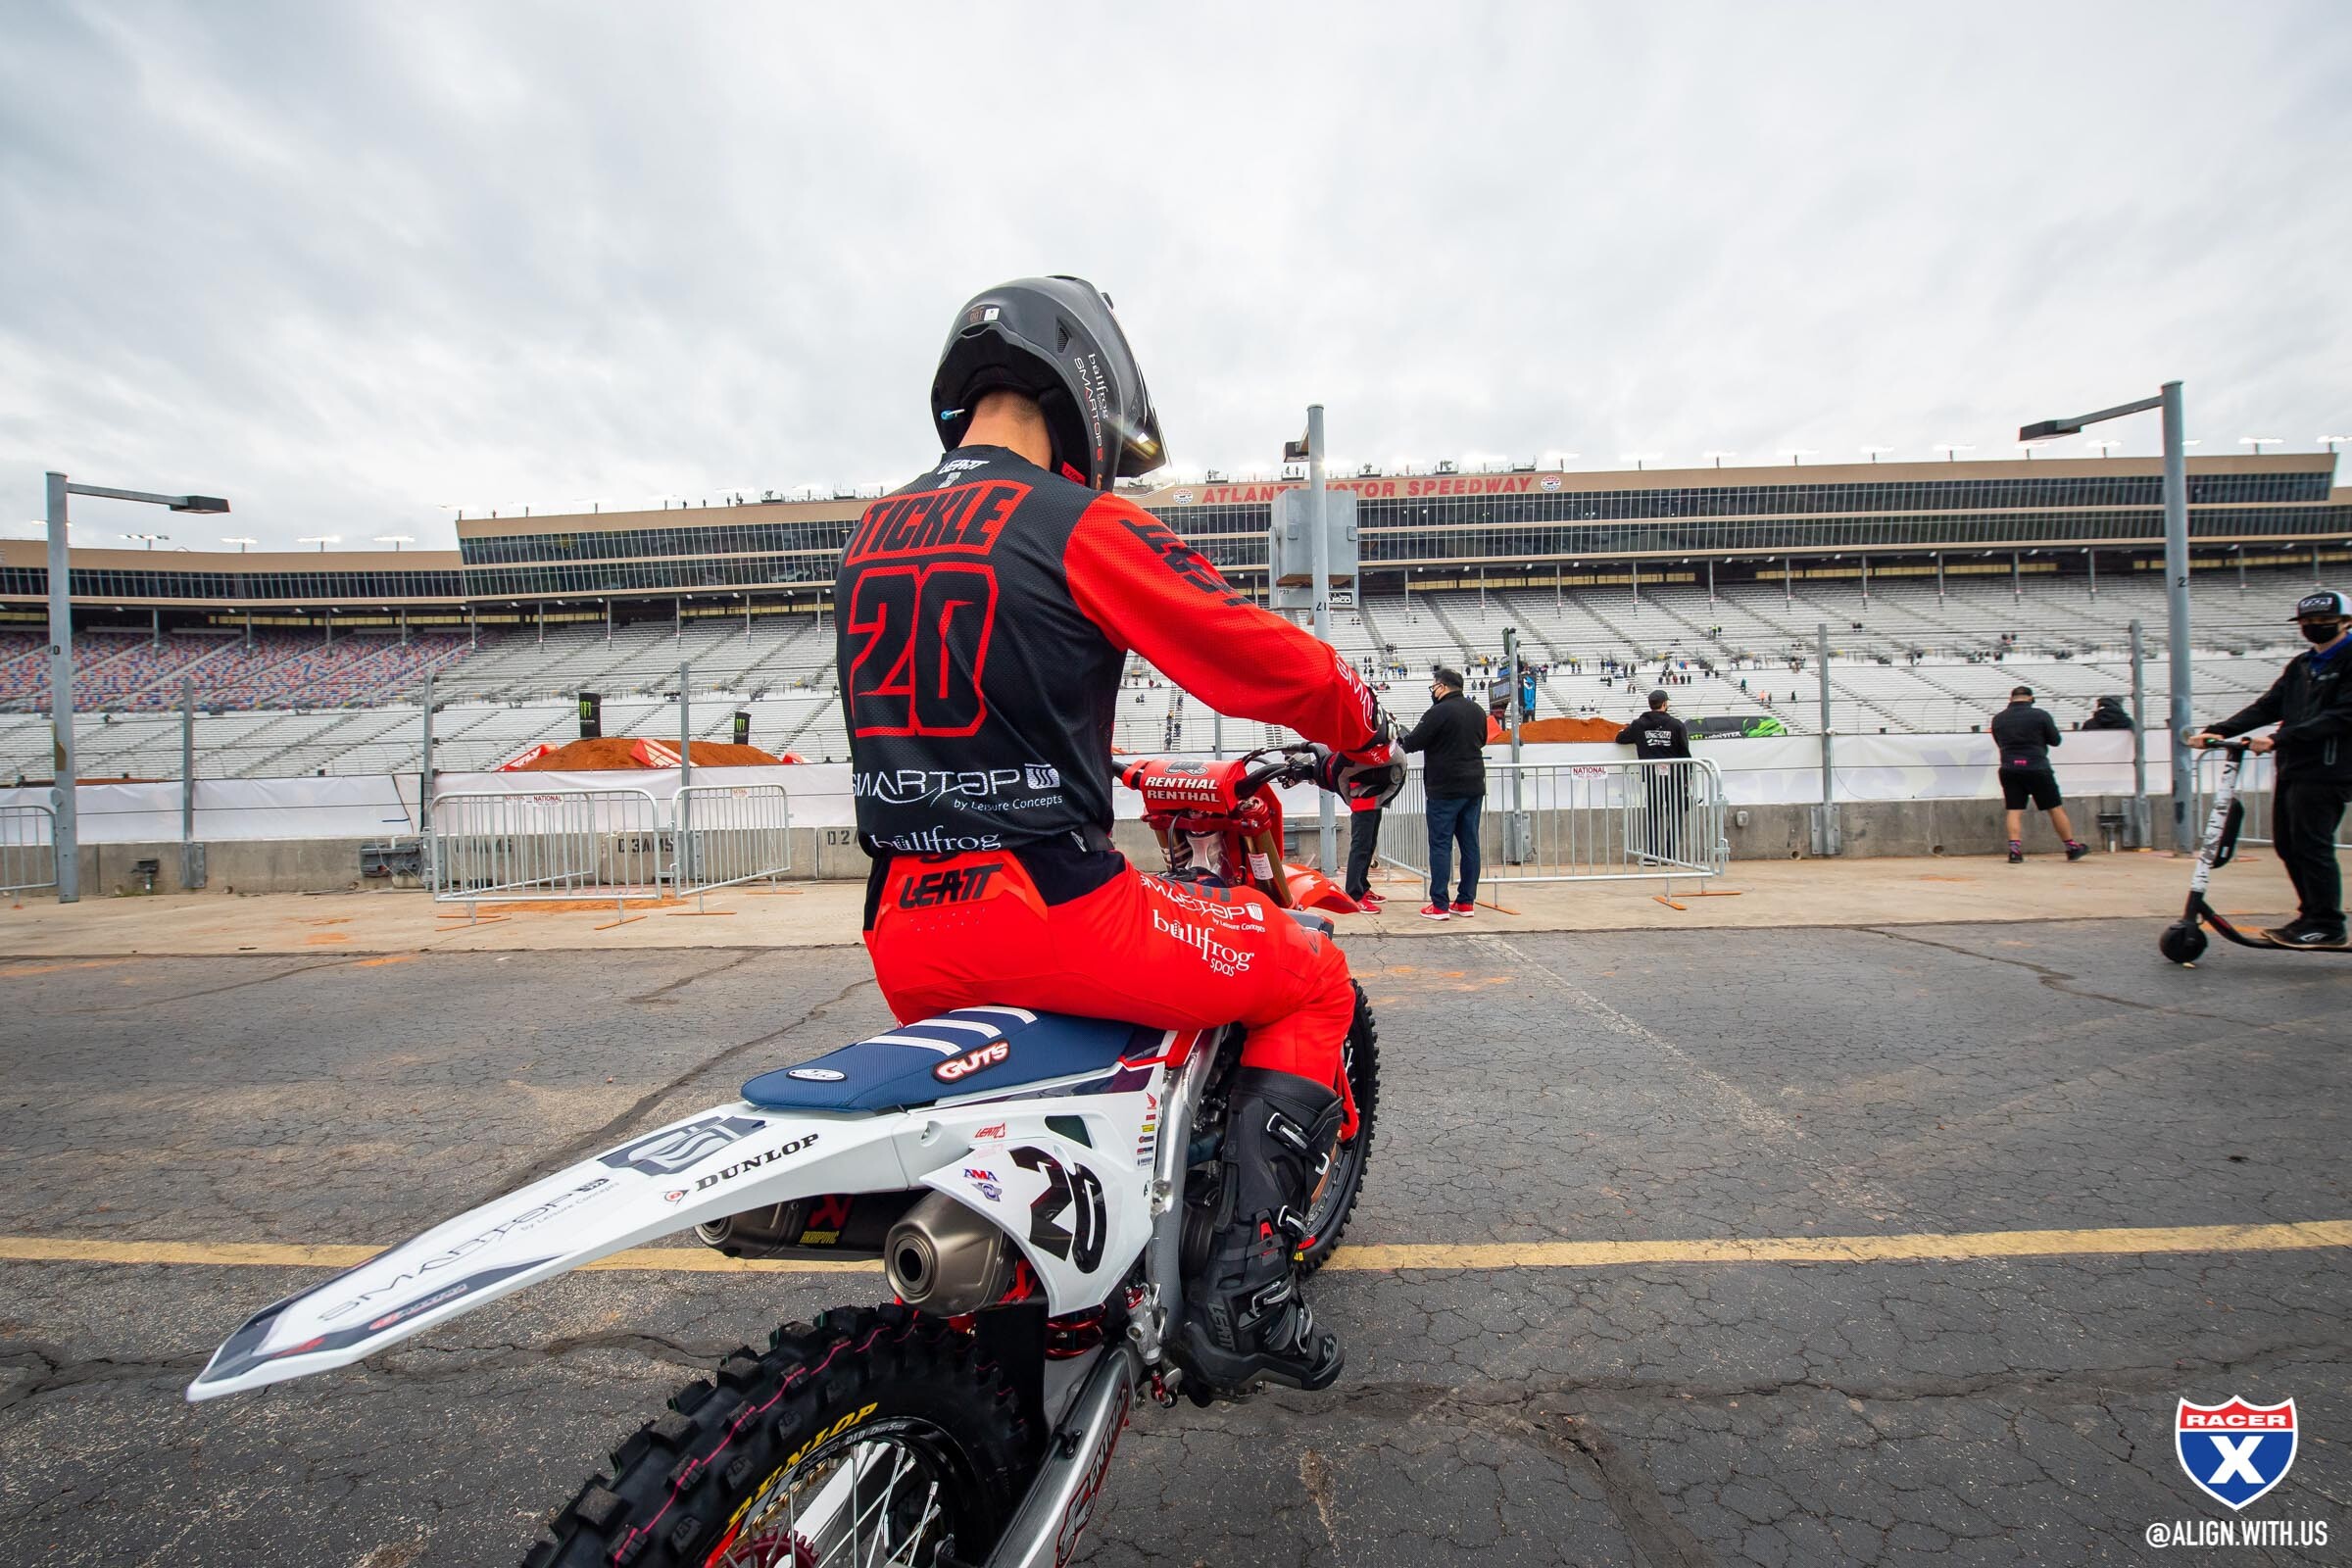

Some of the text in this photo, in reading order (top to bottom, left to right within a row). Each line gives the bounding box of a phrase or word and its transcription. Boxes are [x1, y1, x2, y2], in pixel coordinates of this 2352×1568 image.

[1408, 476, 1532, 497] SPEEDWAY
[854, 485, 1021, 559] TICKLE
[848, 561, 1000, 739] 20
[1145, 776, 1218, 790] RENTHAL
[1573, 767, 1606, 776] NATIONAL
[954, 795, 1063, 811] by Leisure Concepts
[1148, 790, 1221, 803] RENTHAL
[869, 825, 1003, 854] bullfrog
[900, 862, 1004, 909] LEATT
[1152, 908, 1254, 971] bullfrog
[1209, 957, 1235, 977] spas
[937, 1041, 1009, 1079] GUTS
[695, 1133, 819, 1192] DUNLOP
[962, 1167, 1000, 1183] AMA
[1007, 1145, 1108, 1274] 20
[724, 1401, 879, 1536] DUNLOP
